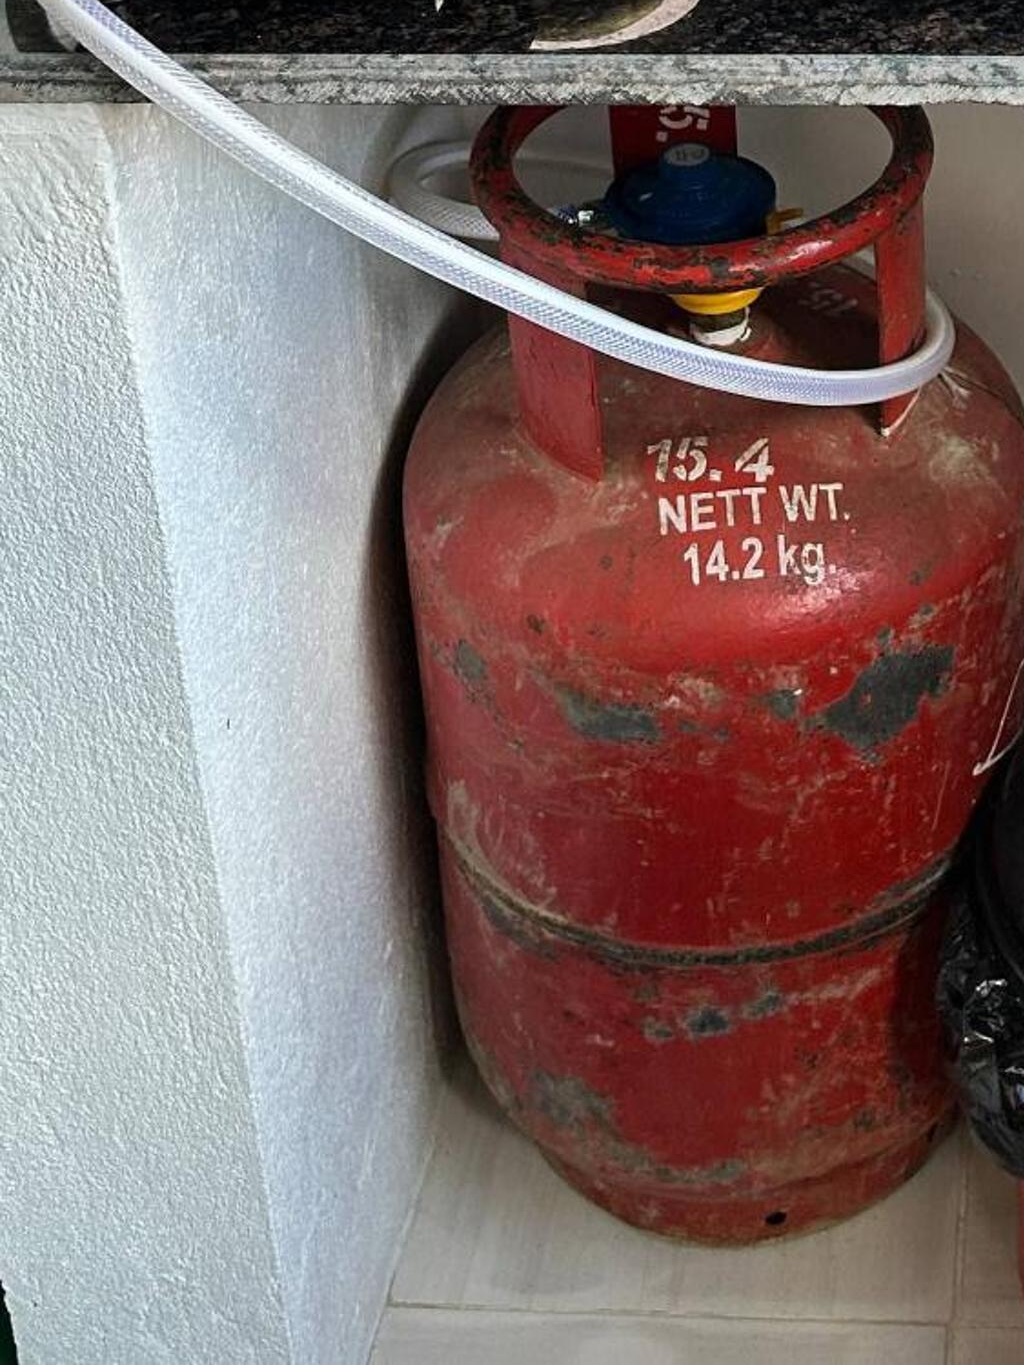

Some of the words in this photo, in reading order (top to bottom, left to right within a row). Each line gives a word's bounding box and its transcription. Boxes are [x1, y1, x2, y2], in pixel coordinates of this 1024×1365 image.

[658, 486, 768, 536] NETT
[778, 482, 850, 523] WT.
[683, 536, 765, 587] 14.2
